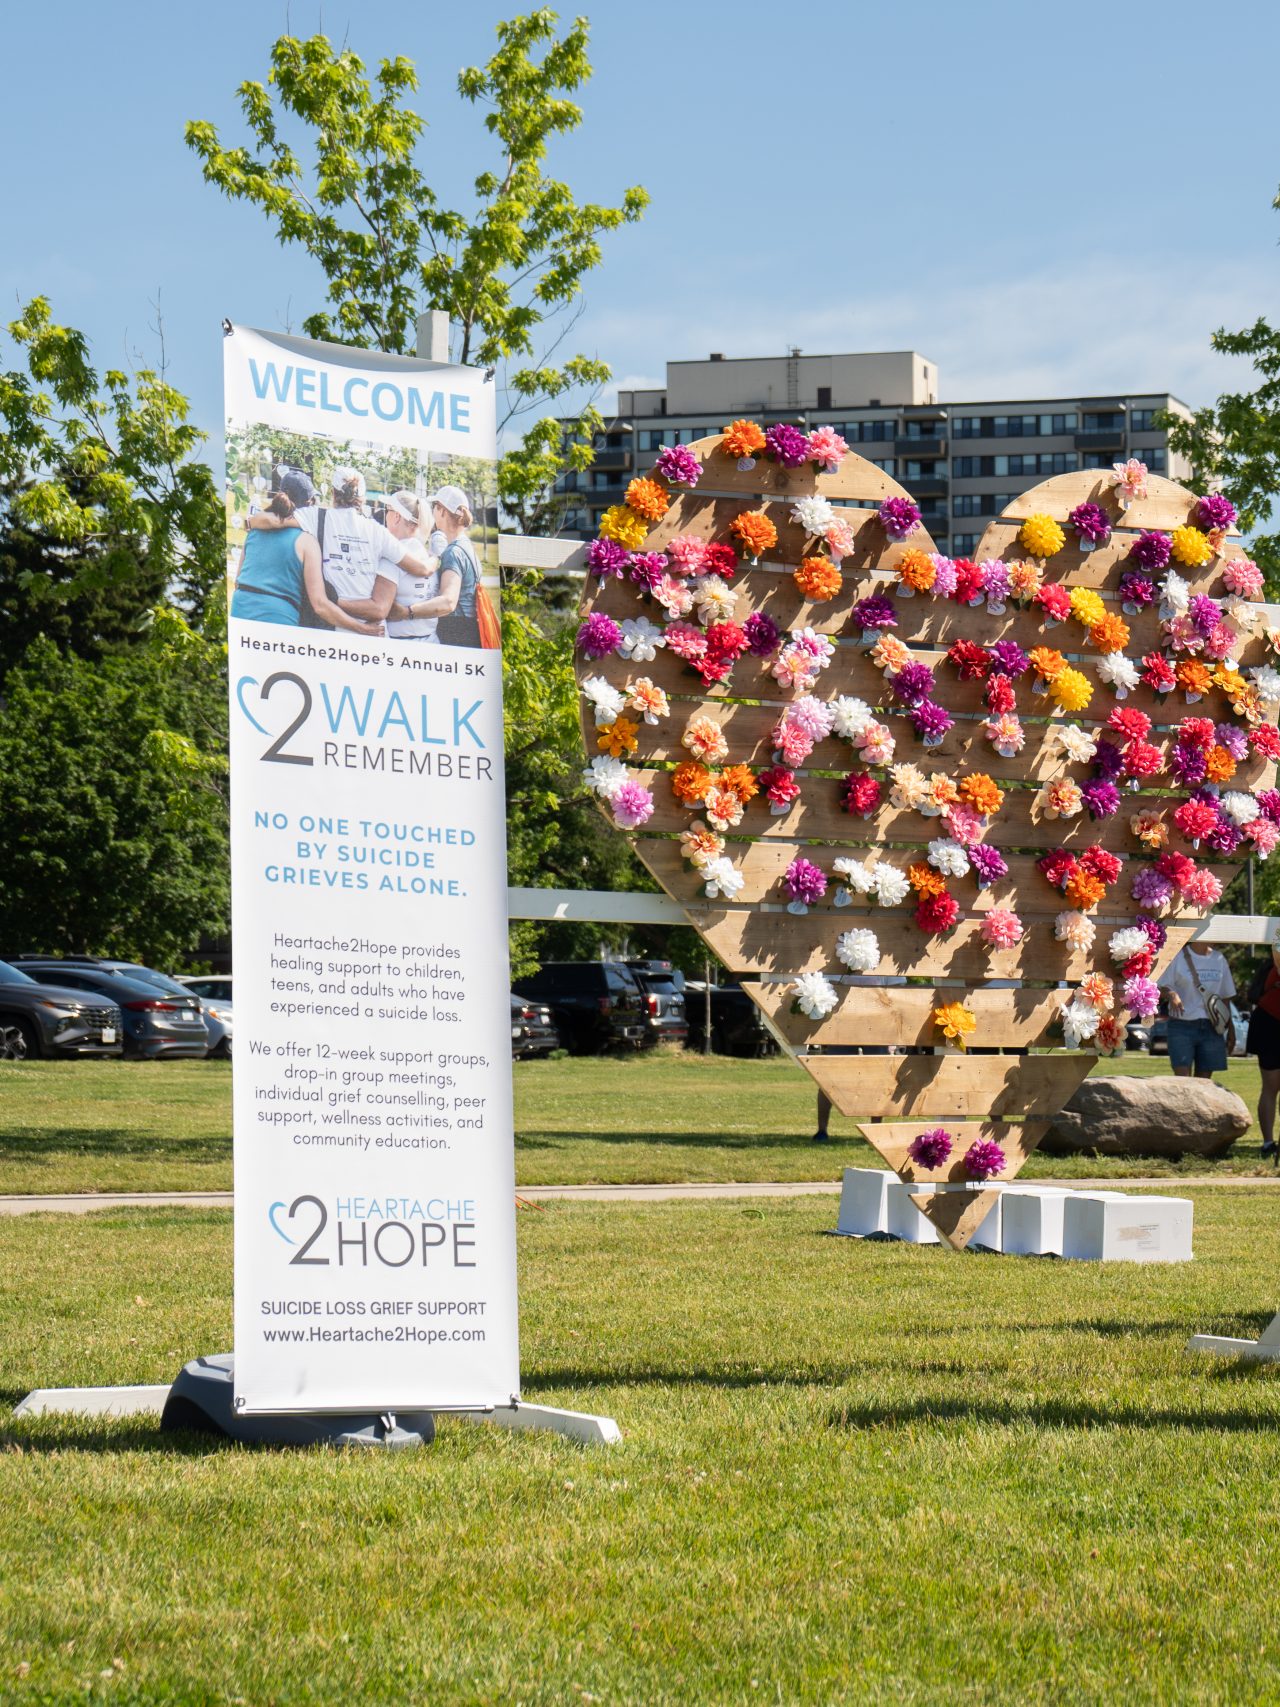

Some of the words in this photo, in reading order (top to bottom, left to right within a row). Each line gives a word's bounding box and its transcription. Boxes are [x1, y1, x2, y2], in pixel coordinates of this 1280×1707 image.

[248, 359, 470, 433] WELCOME
[241, 636, 393, 666] Heartache2Hope's
[401, 657, 457, 673] Annual
[465, 664, 485, 676] 5K
[260, 672, 314, 766] 2
[320, 683, 486, 748] WALK
[325, 742, 493, 781] REMEMBER
[255, 811, 288, 830] NO
[299, 816, 349, 835] ONE
[360, 821, 475, 845] TOUCHED
[297, 842, 327, 859] BY
[338, 845, 434, 868] SUICIDE
[265, 865, 368, 889] GRIEVES
[379, 875, 468, 896] ALONE.
[274, 933, 397, 958] Heartache2Hope
[402, 944, 460, 959] provides
[271, 953, 322, 975] healing
[328, 963, 382, 978] support
[386, 964, 400, 976] to
[406, 963, 464, 982] children,
[271, 978, 313, 994] teens,
[319, 980, 345, 994] and
[351, 981, 393, 997] adults
[399, 984, 427, 998] who
[432, 985, 464, 1000] have
[271, 1002, 359, 1017] experienced
[365, 1008, 373, 1017] a
[378, 1005, 427, 1020] suicide
[432, 1006, 461, 1022] loss.
[249, 1041, 271, 1055] We
[277, 1041, 311, 1057] offer
[316, 1044, 375, 1060] 12-week
[380, 1051, 433, 1066] support
[438, 1055, 489, 1069] groups,
[285, 1064, 337, 1083] drop-in
[342, 1072, 383, 1086] group
[389, 1072, 456, 1089] meetings,
[256, 1085, 322, 1101] individual
[329, 1088, 361, 1106] grief
[367, 1091, 449, 1110] counselling,
[454, 1098, 486, 1111] peer
[258, 1111, 316, 1126] support,
[322, 1109, 381, 1125] wellness
[386, 1114, 452, 1129] activities,
[457, 1114, 483, 1128] and
[293, 1134, 370, 1151] community
[376, 1133, 450, 1149] education.
[288, 1195, 329, 1265] 2
[336, 1198, 474, 1220] HEARTACHE
[338, 1221, 476, 1267] HOPE
[261, 1301, 321, 1315] SUICIDE
[326, 1302, 366, 1315] LOSS
[370, 1302, 413, 1315] GRIEF
[418, 1302, 486, 1315] SUPPORT
[264, 1327, 485, 1344] www.Heartache2Hope.com
